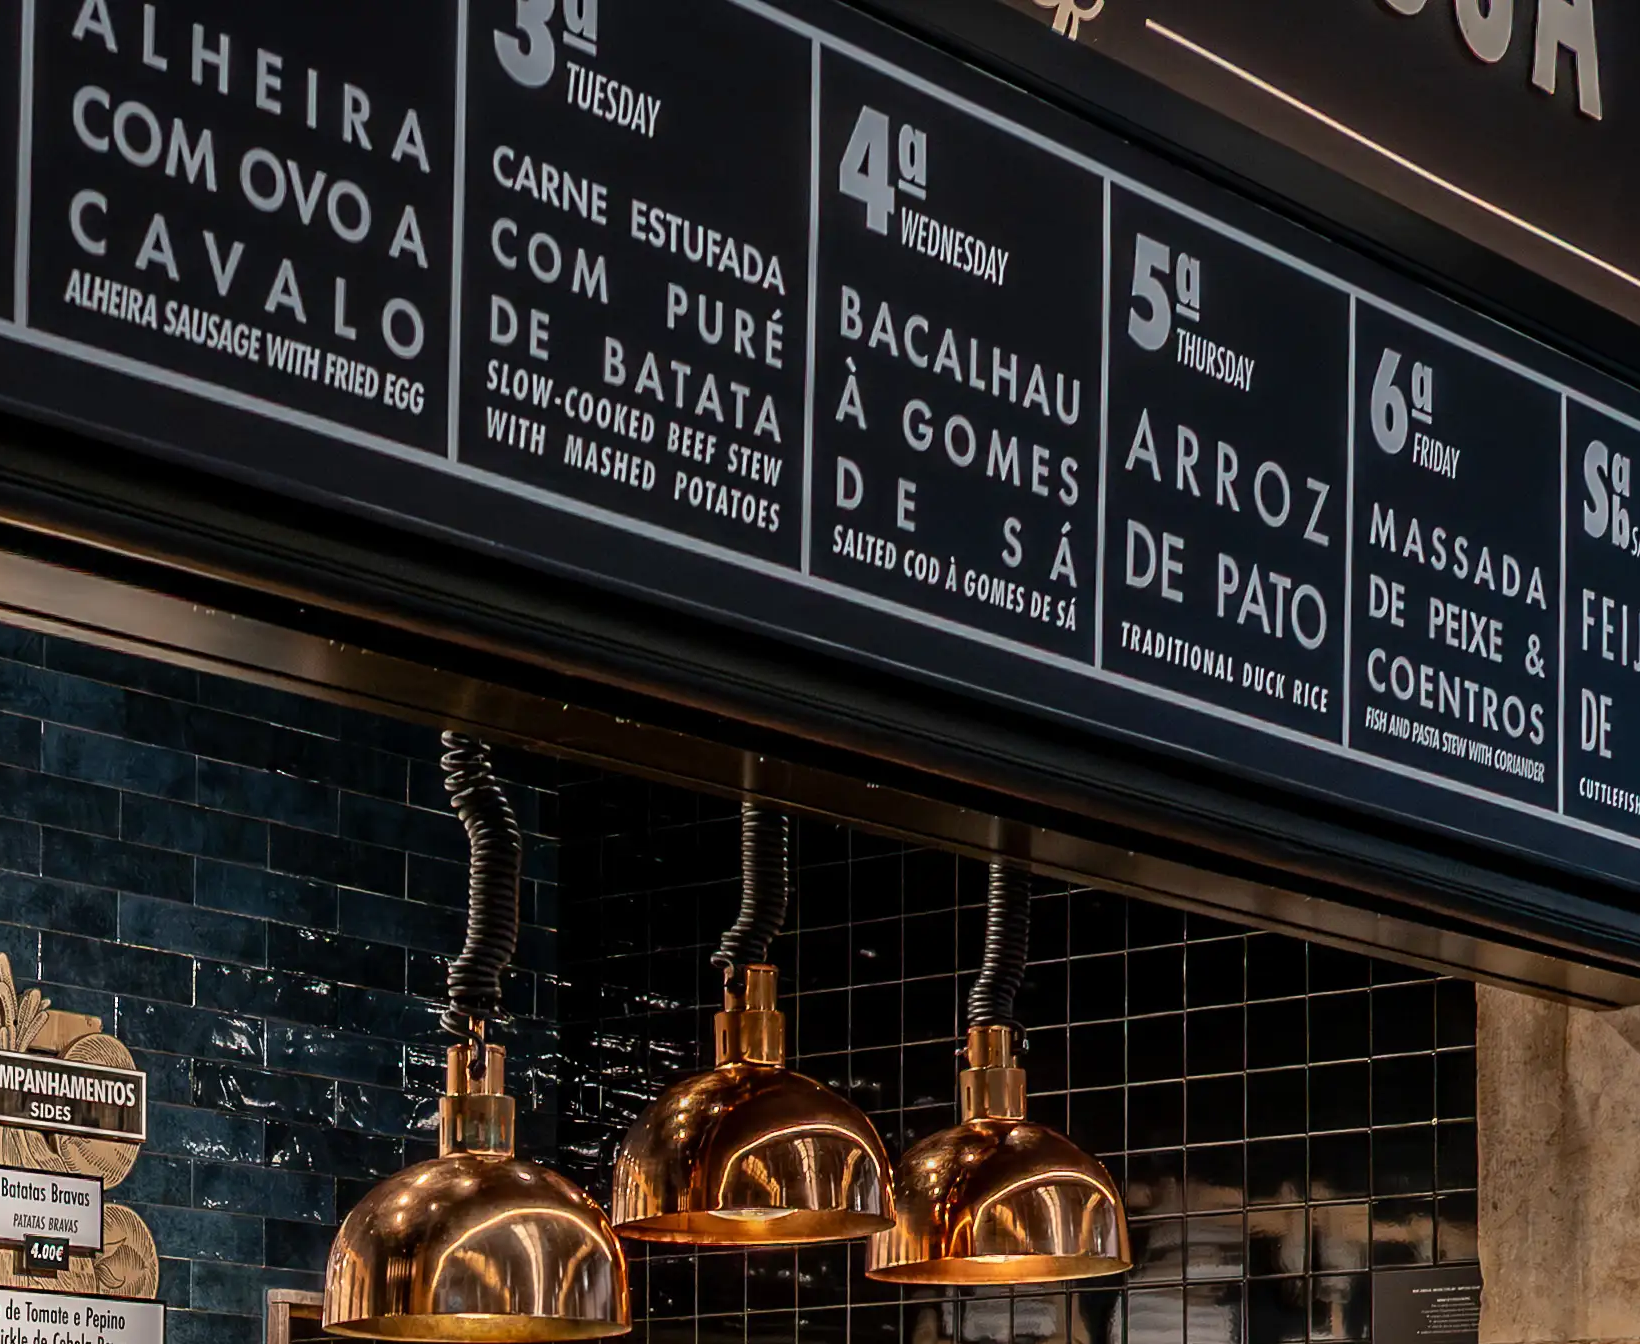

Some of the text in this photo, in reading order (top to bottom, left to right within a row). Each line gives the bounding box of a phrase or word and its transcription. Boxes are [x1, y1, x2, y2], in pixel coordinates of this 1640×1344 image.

[72, 0, 430, 173] ALHEIRA
[566, 61, 660, 138] TUESDAY
[72, 85, 428, 268] COM OVO A
[492, 146, 786, 295] CARNE ESTUFADA
[68, 188, 424, 359] CAVALO
[490, 217, 782, 369] COM PURÉ
[900, 206, 1009, 286] WEDNESDAY
[64, 269, 425, 414] ALHEIRA SAUSAGE WITH FRIED EGG
[489, 294, 781, 443] DE BATATA
[839, 284, 1080, 426] BACALHAU
[1176, 328, 1254, 392] THURSDAY
[486, 359, 782, 487] SLOW-COOKED BEEF STEW
[486, 407, 780, 533] WITH MASHED POTATOES
[835, 357, 1079, 506] À GOMES
[1125, 408, 1330, 547] ARROZ
[1413, 432, 1460, 480] FRIDAY
[835, 456, 1078, 588] DE SÁ
[1125, 519, 1327, 650] DE PATO
[1369, 502, 1547, 610] MASSADA
[1121, 621, 1329, 713] TRADITIONAL DUCK RICE
[1369, 573, 1545, 679] DE PEIXE &
[1366, 648, 1545, 745] COENTROS
[1581, 688, 1613, 759] DE
[30, 1101, 71, 1122] SIDES
[1, 1177, 90, 1207] Batatas Bravas
[13, 1213, 78, 1233] PATATAS BRAVAS
[30, 1242, 64, 1261] 4.00€
